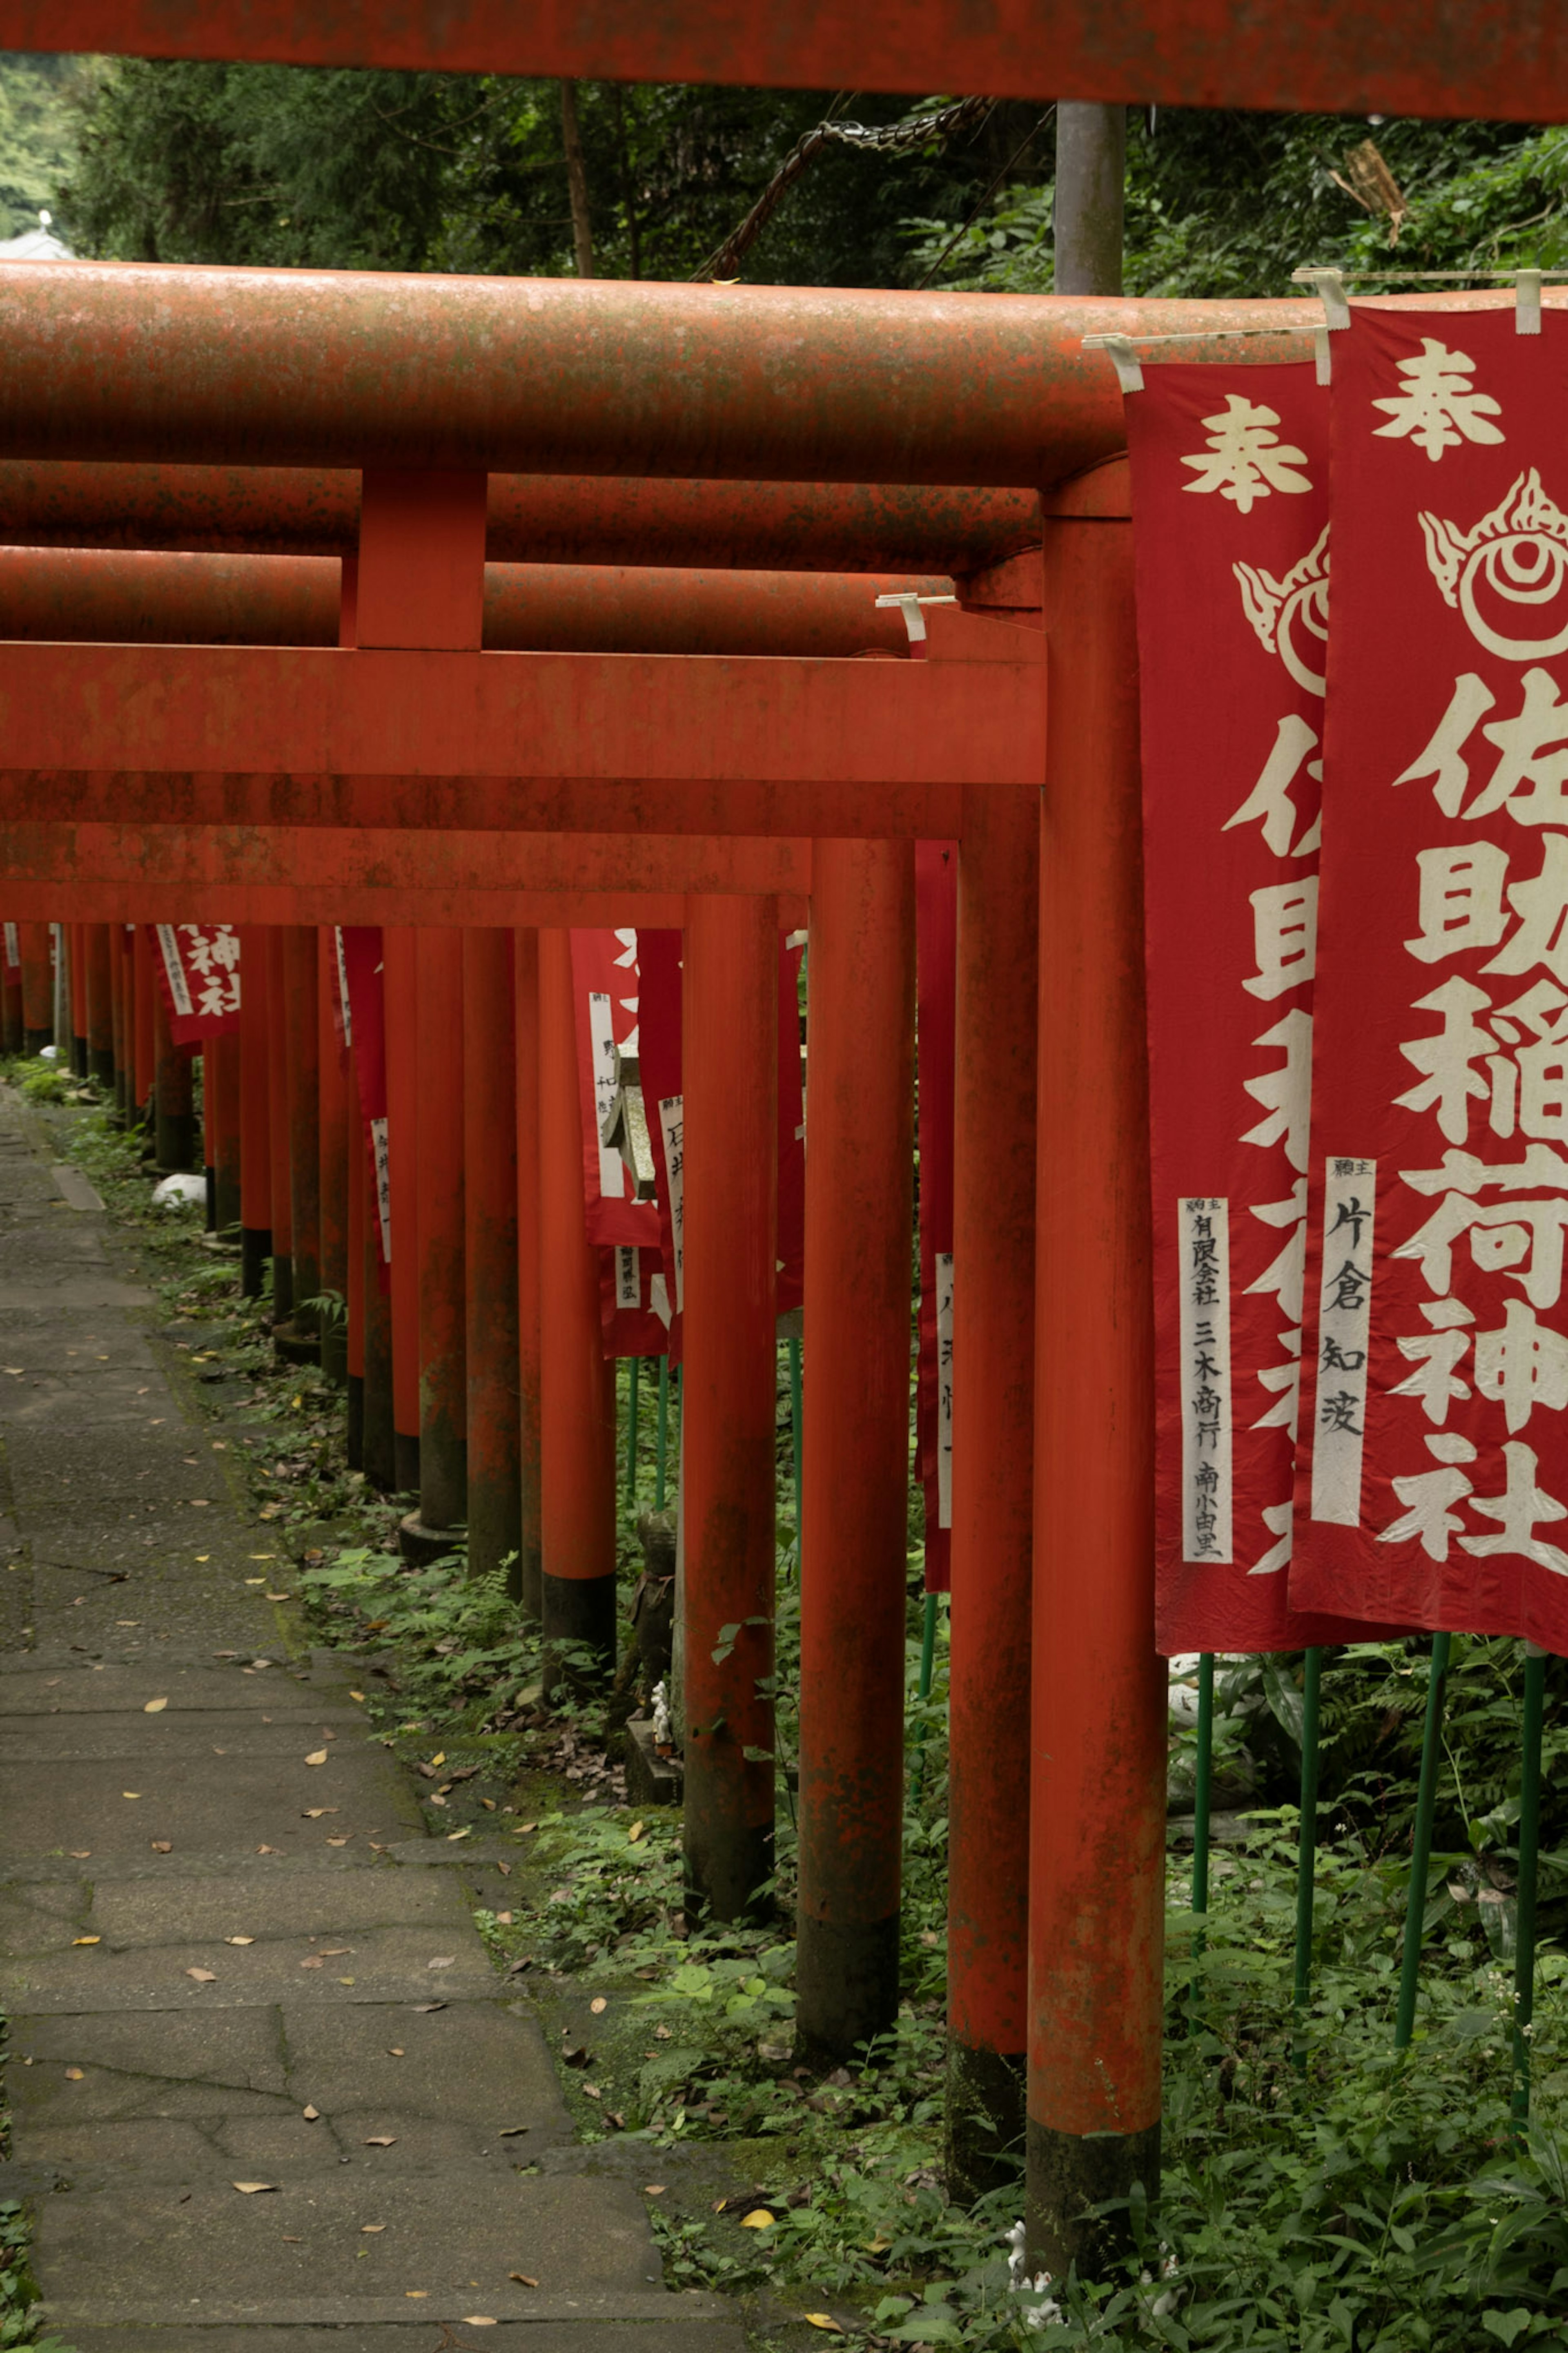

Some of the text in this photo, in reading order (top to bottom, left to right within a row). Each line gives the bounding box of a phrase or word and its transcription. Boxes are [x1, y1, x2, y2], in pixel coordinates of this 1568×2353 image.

[1181, 395, 1313, 513] 奉
[1372, 338, 1506, 461] 奉
[179, 925, 240, 1015] 神社
[1333, 1159, 1372, 1177] 願主
[1374, 667, 1568, 1576] 佐助稲荷神社
[1191, 1215, 1219, 1305] 有限会社
[1192, 1322, 1222, 1449] 三木商行
